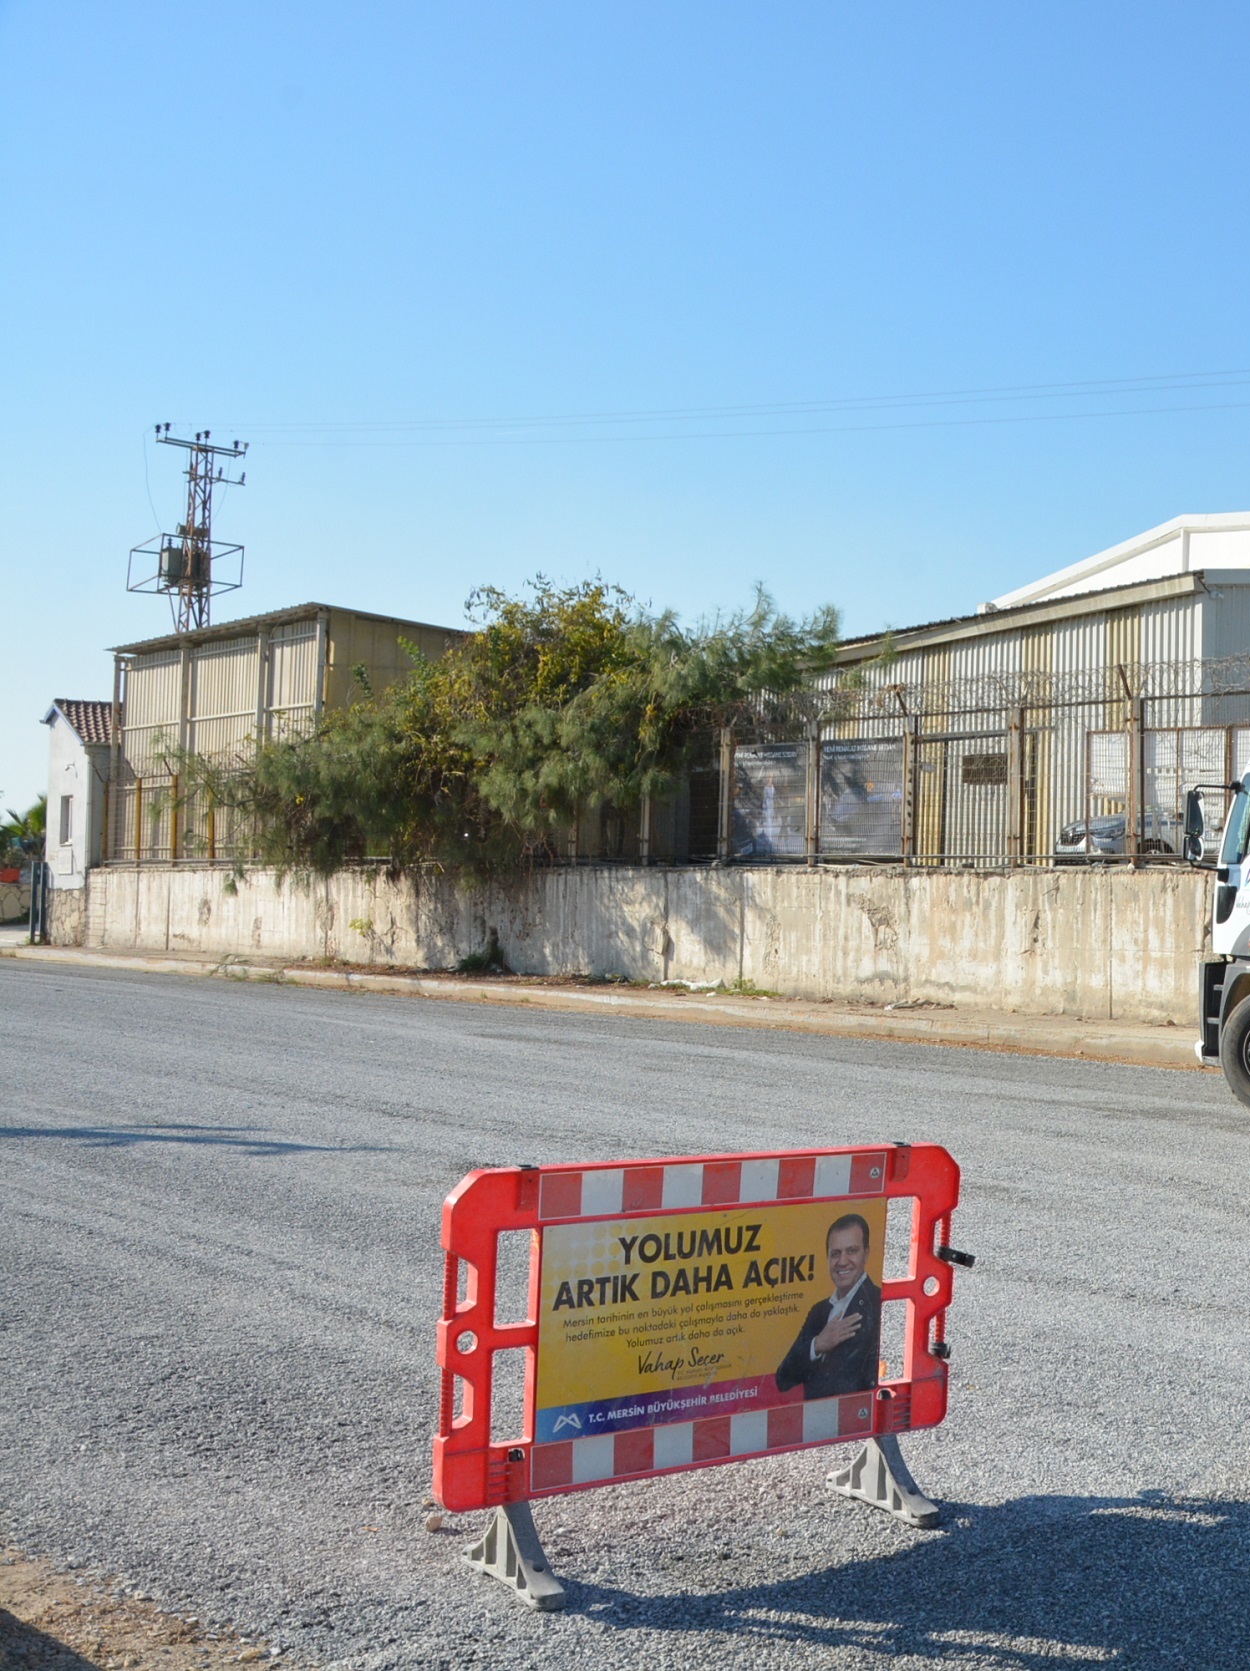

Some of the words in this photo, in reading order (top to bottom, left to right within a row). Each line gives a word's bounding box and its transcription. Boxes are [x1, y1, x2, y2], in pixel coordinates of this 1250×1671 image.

[617, 1224, 763, 1265] YOLUMUZ
[552, 1273, 640, 1311] ARTIK
[650, 1263, 734, 1300] DAHA
[742, 1254, 815, 1289] AÇIK!
[563, 1317, 594, 1329] Mersin
[596, 1311, 635, 1324] tarihinin
[637, 1310, 649, 1320] en
[651, 1305, 678, 1318] büyük
[680, 1303, 694, 1316] yol
[695, 1298, 742, 1313] çalışmasını
[744, 1291, 804, 1308] gerçekleştirme
[565, 1329, 616, 1342] hedefimize
[618, 1325, 630, 1336] bu
[632, 1320, 677, 1334] noktadaki
[679, 1313, 724, 1329] çalışmayla
[726, 1311, 748, 1321] daha
[750, 1309, 761, 1319] da
[763, 1303, 800, 1319] yaklaştık.
[626, 1337, 663, 1348] Yolumuz
[666, 1331, 686, 1343] artık
[688, 1329, 710, 1340] daha
[712, 1327, 725, 1337] da
[726, 1323, 746, 1336] açık.
[638, 1350, 684, 1380] Vahap
[588, 1412, 605, 1424] T.C.
[607, 1405, 645, 1421] MERSİN
[647, 1395, 707, 1415] BÜYÜKŞEHİR
[709, 1386, 758, 1405] BELEDİYESİ
